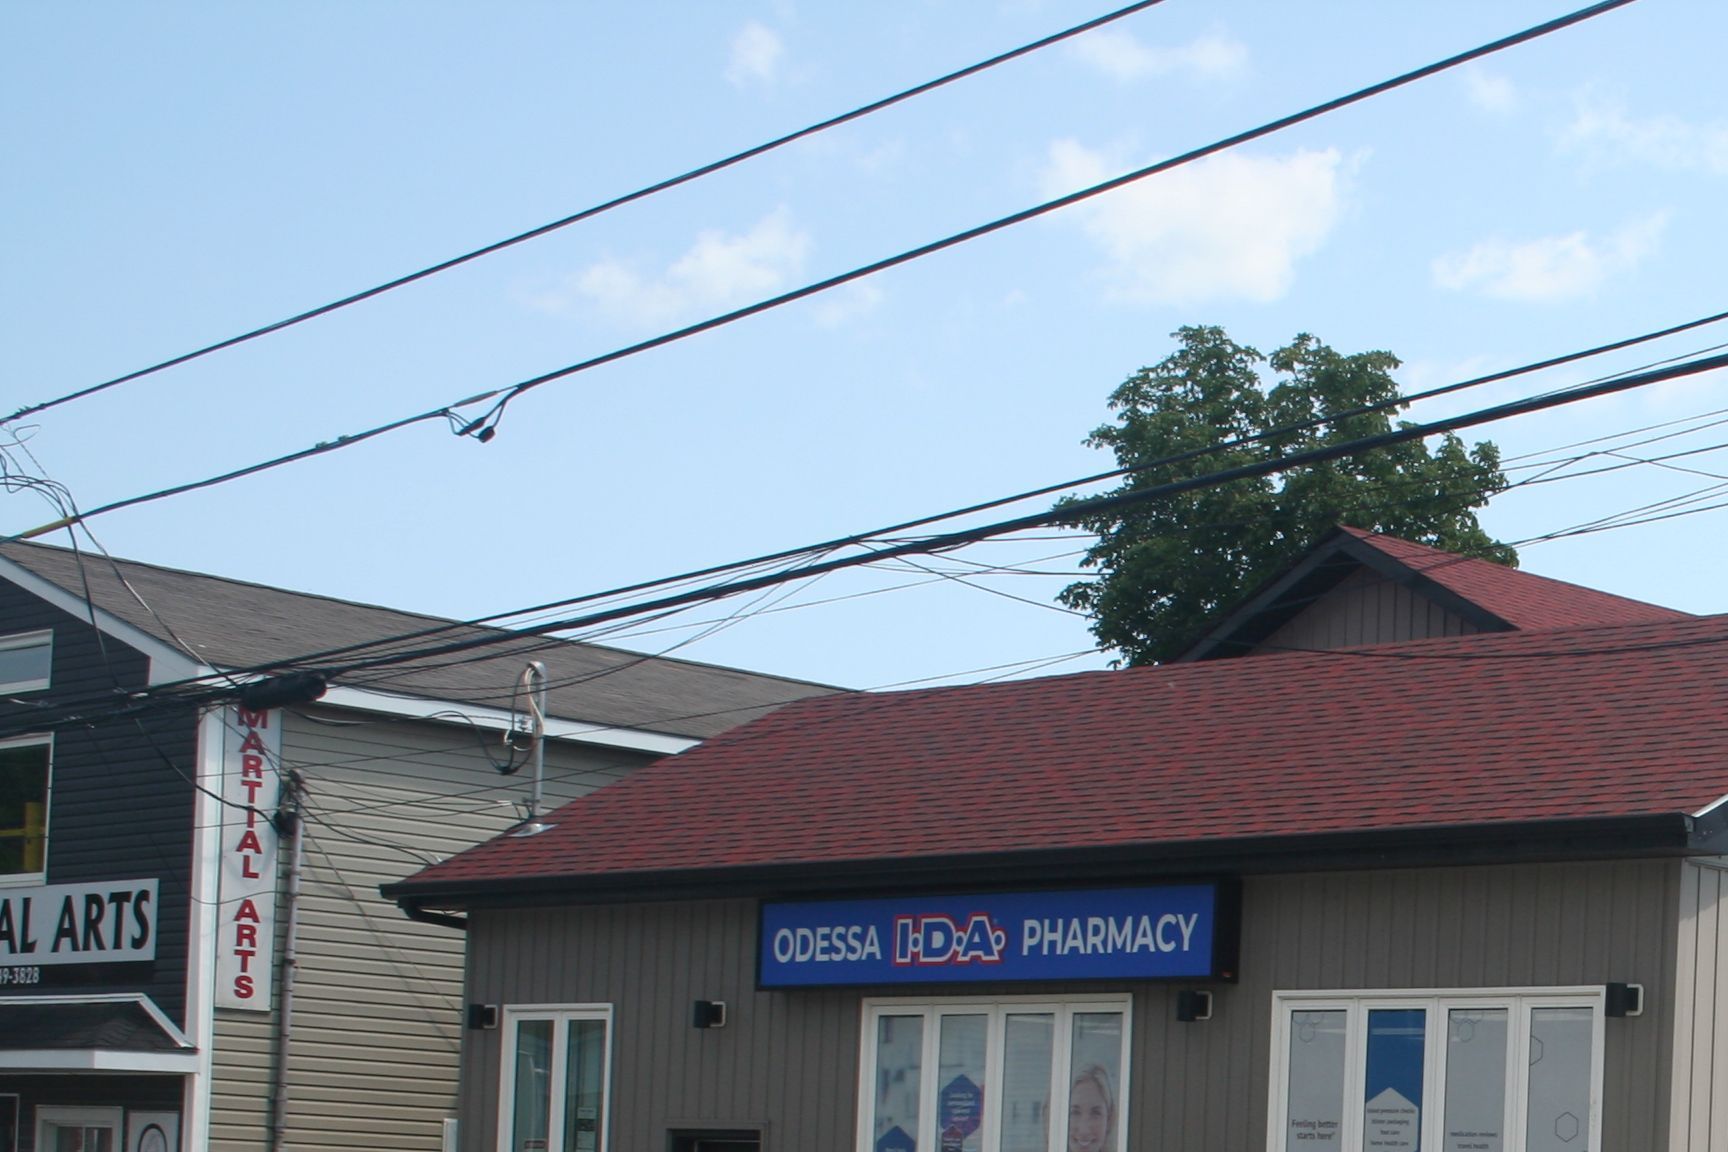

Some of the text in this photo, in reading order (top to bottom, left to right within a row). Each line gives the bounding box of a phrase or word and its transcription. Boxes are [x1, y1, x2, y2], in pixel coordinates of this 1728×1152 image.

[235, 706, 268, 880] MARTIAL
[51, 889, 150, 953] ARTS
[233, 899, 260, 1000] ARTS
[774, 925, 882, 963] ODESSA
[1022, 913, 1198, 956] PHARMACY
[1292, 1120, 1338, 1130] Feeling better
[1297, 1131, 1315, 1140] starts
